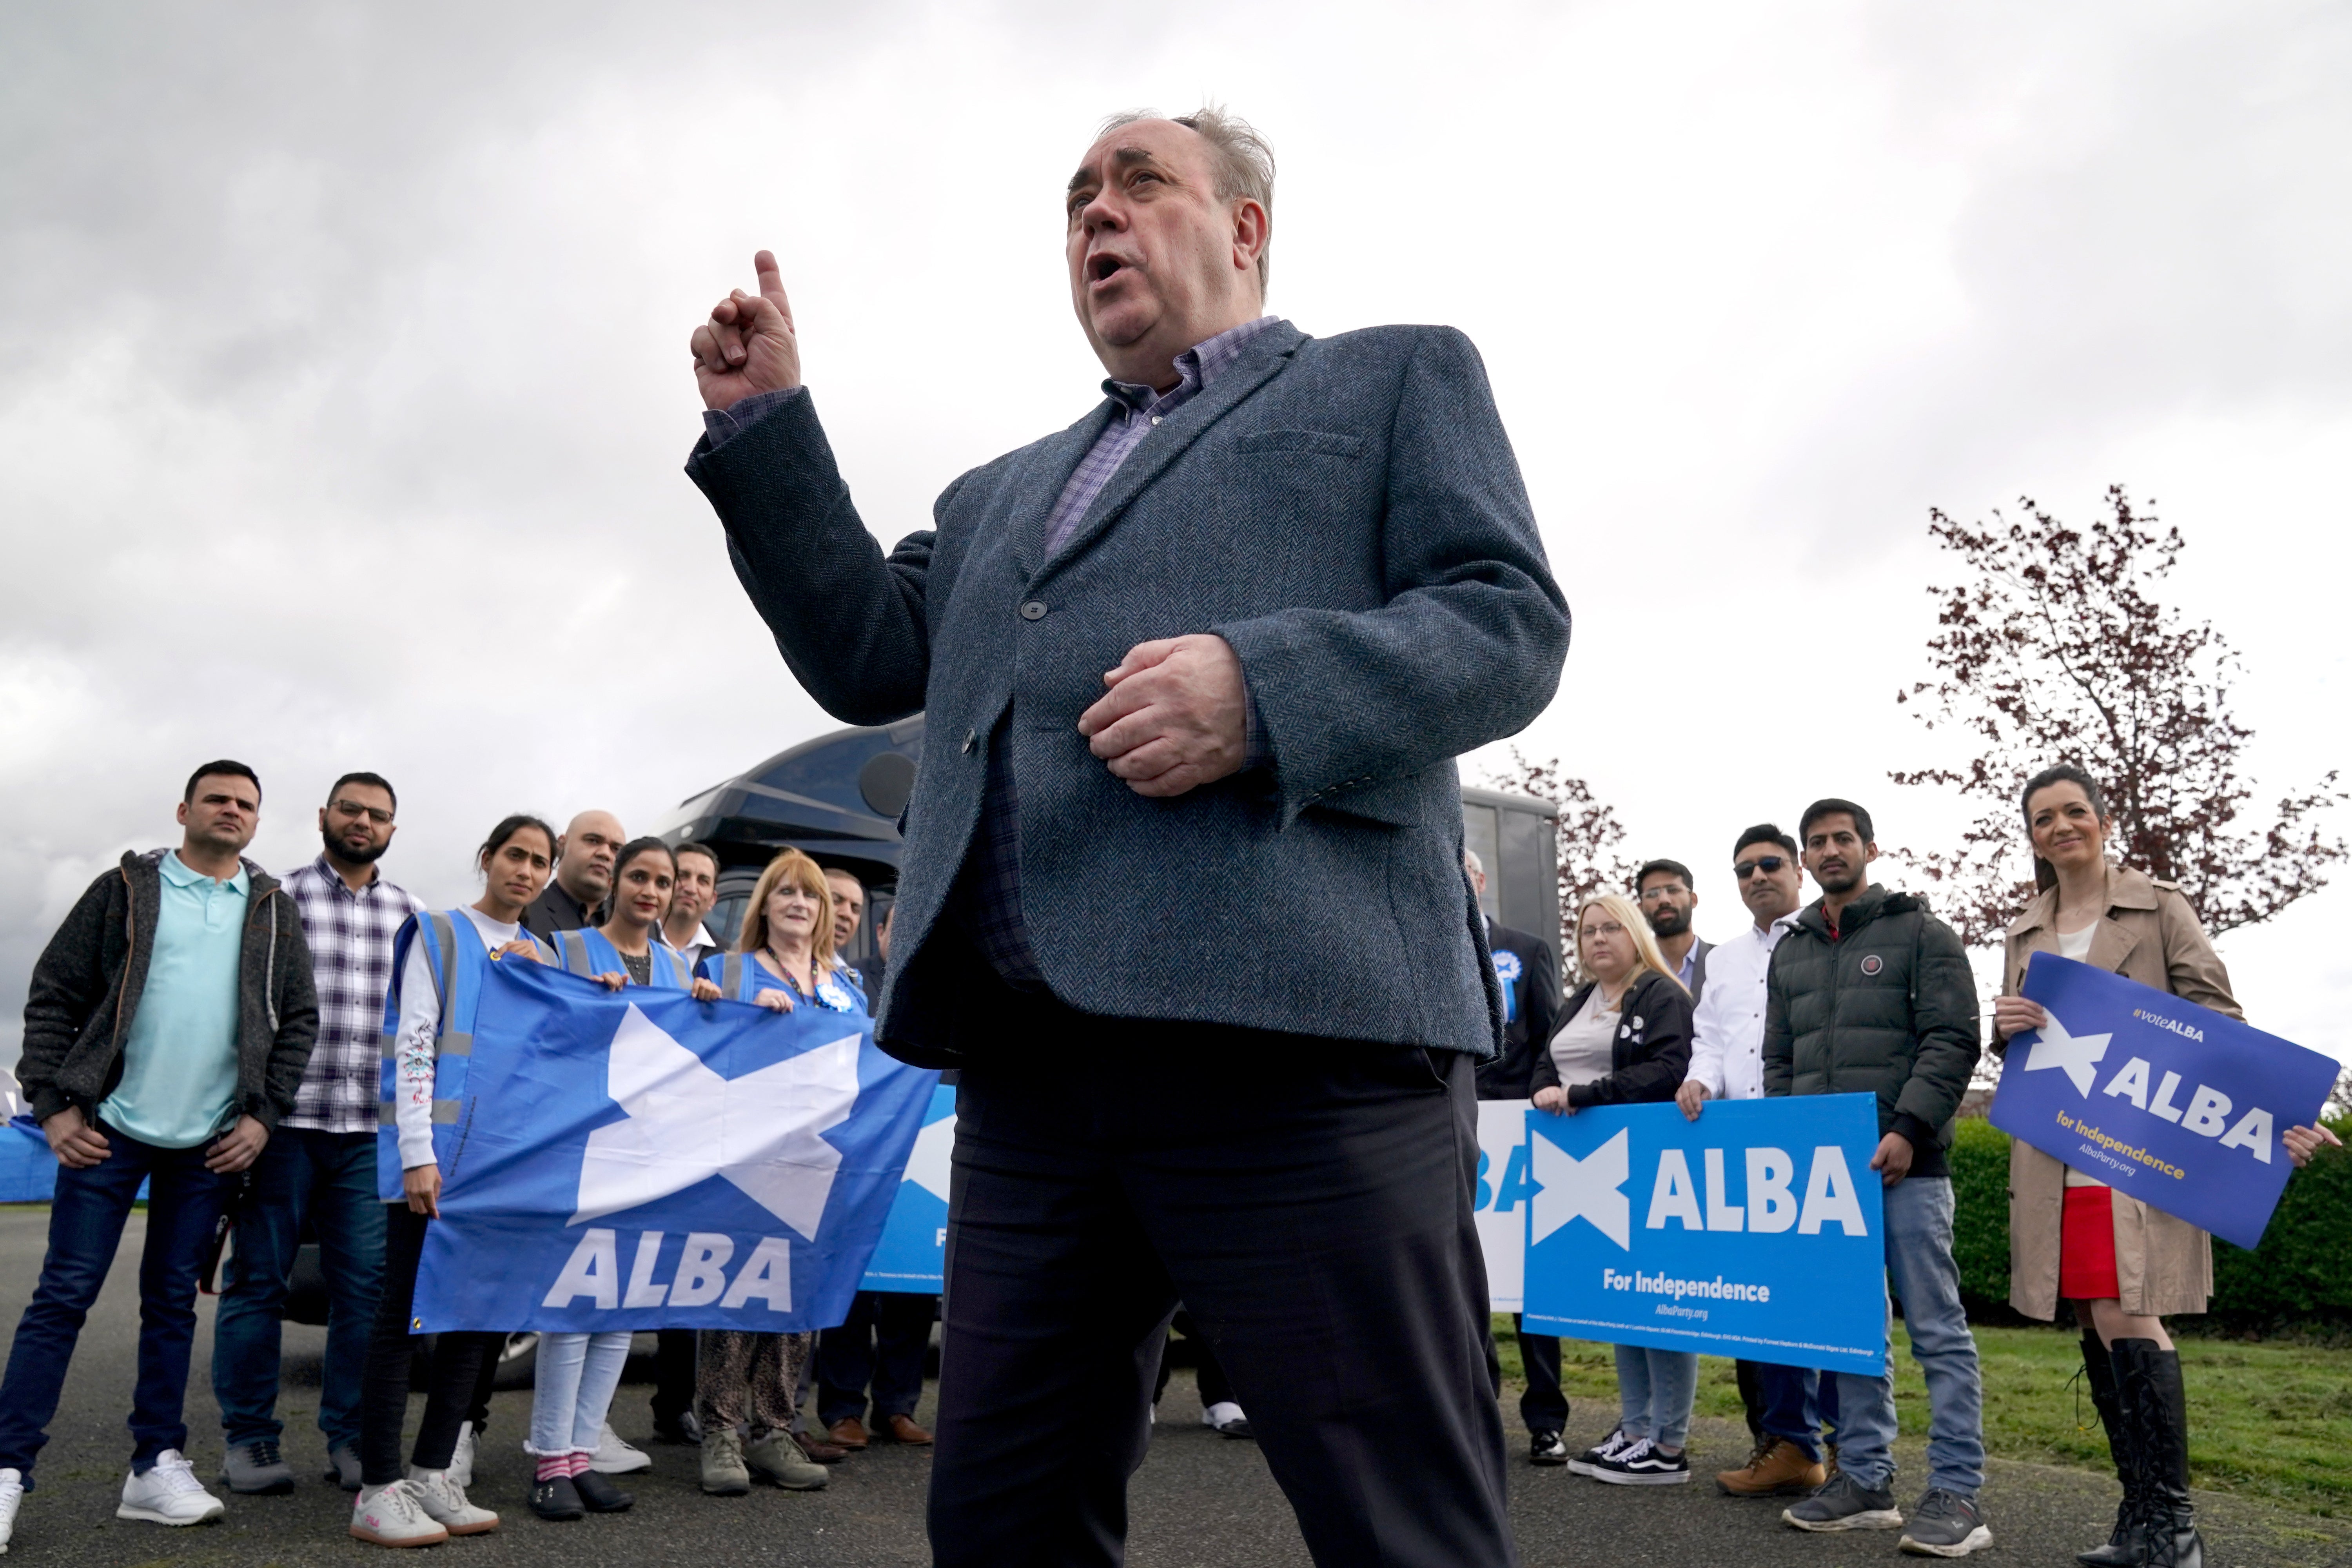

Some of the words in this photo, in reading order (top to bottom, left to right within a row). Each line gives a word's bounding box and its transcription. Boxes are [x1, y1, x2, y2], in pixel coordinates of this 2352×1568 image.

[2132, 1009, 2204, 1043] #voteALBA
[2103, 1056, 2274, 1164] ALBA
[2056, 1110, 2074, 1128] for
[2075, 1120, 2185, 1179] Independence
[2079, 1143, 2136, 1177] AlbaParty.org
[1646, 1145, 1868, 1236] ALBA
[541, 1228, 792, 1313] ALBA
[1603, 1268, 1633, 1291] For
[1636, 1270, 1770, 1302] Independence
[1655, 1304, 1709, 1322] AlbaParty.org
